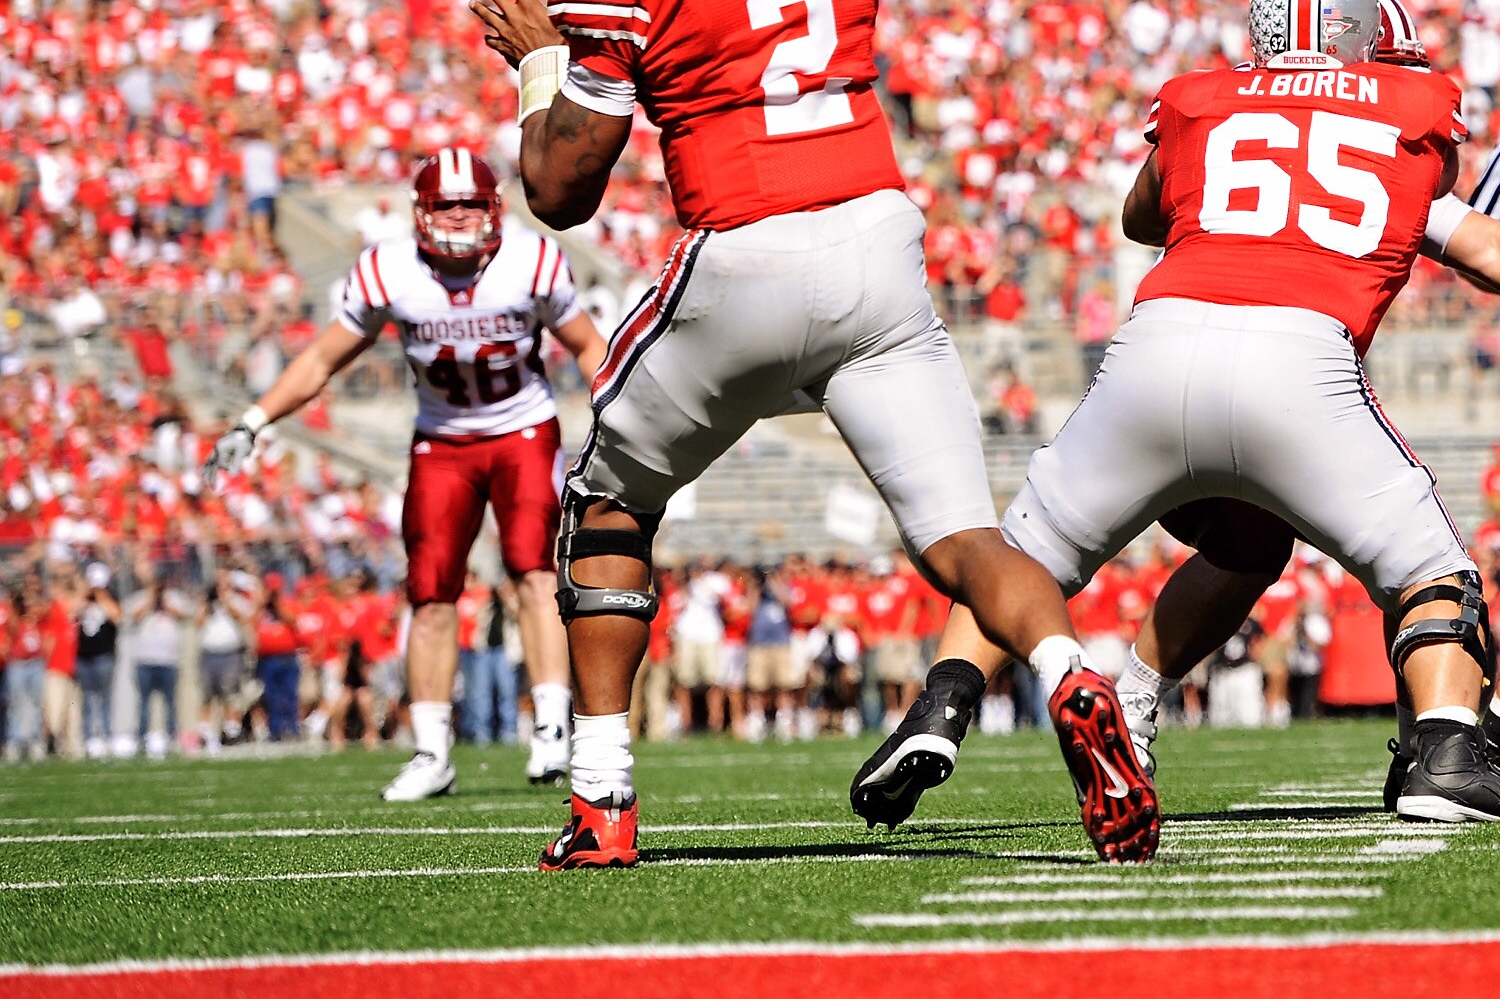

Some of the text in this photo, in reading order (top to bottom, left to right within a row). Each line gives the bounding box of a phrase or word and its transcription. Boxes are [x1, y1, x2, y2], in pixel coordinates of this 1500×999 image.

[1271, 36, 1285, 51] 32
[1325, 44, 1338, 55] 65
[1283, 56, 1327, 65] BUCKEYES
[1199, 110, 1402, 259] 65
[427, 342, 520, 408] 46
